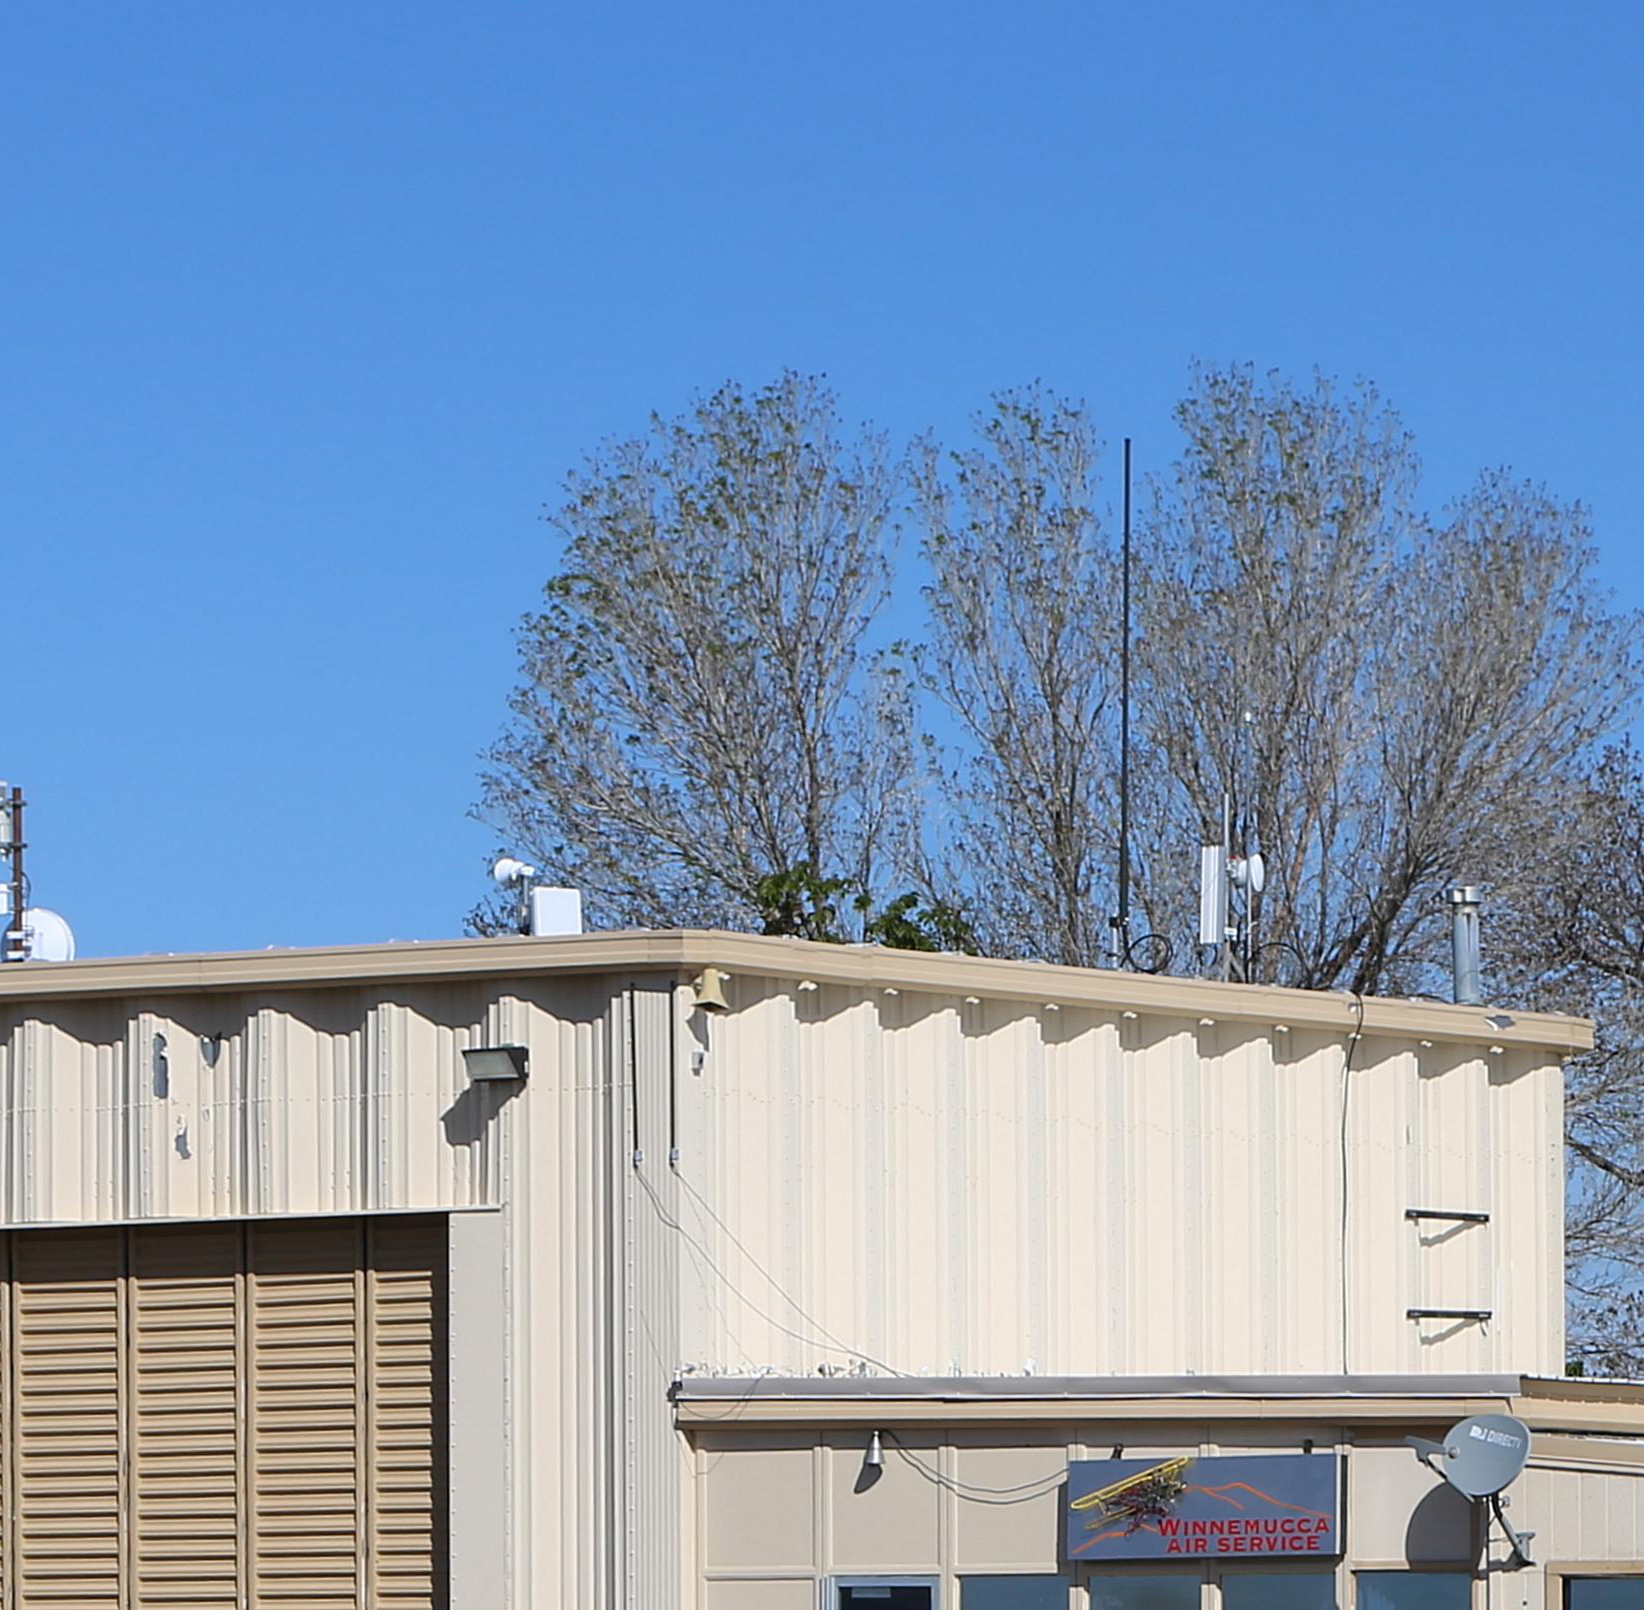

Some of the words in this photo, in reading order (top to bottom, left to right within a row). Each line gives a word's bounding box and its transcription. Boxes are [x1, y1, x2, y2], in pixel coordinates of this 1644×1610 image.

[1157, 1517, 1330, 1537] WINNEMUCCA
[1166, 1537, 1208, 1553] AIR
[1217, 1535, 1321, 1552] SERVICE
